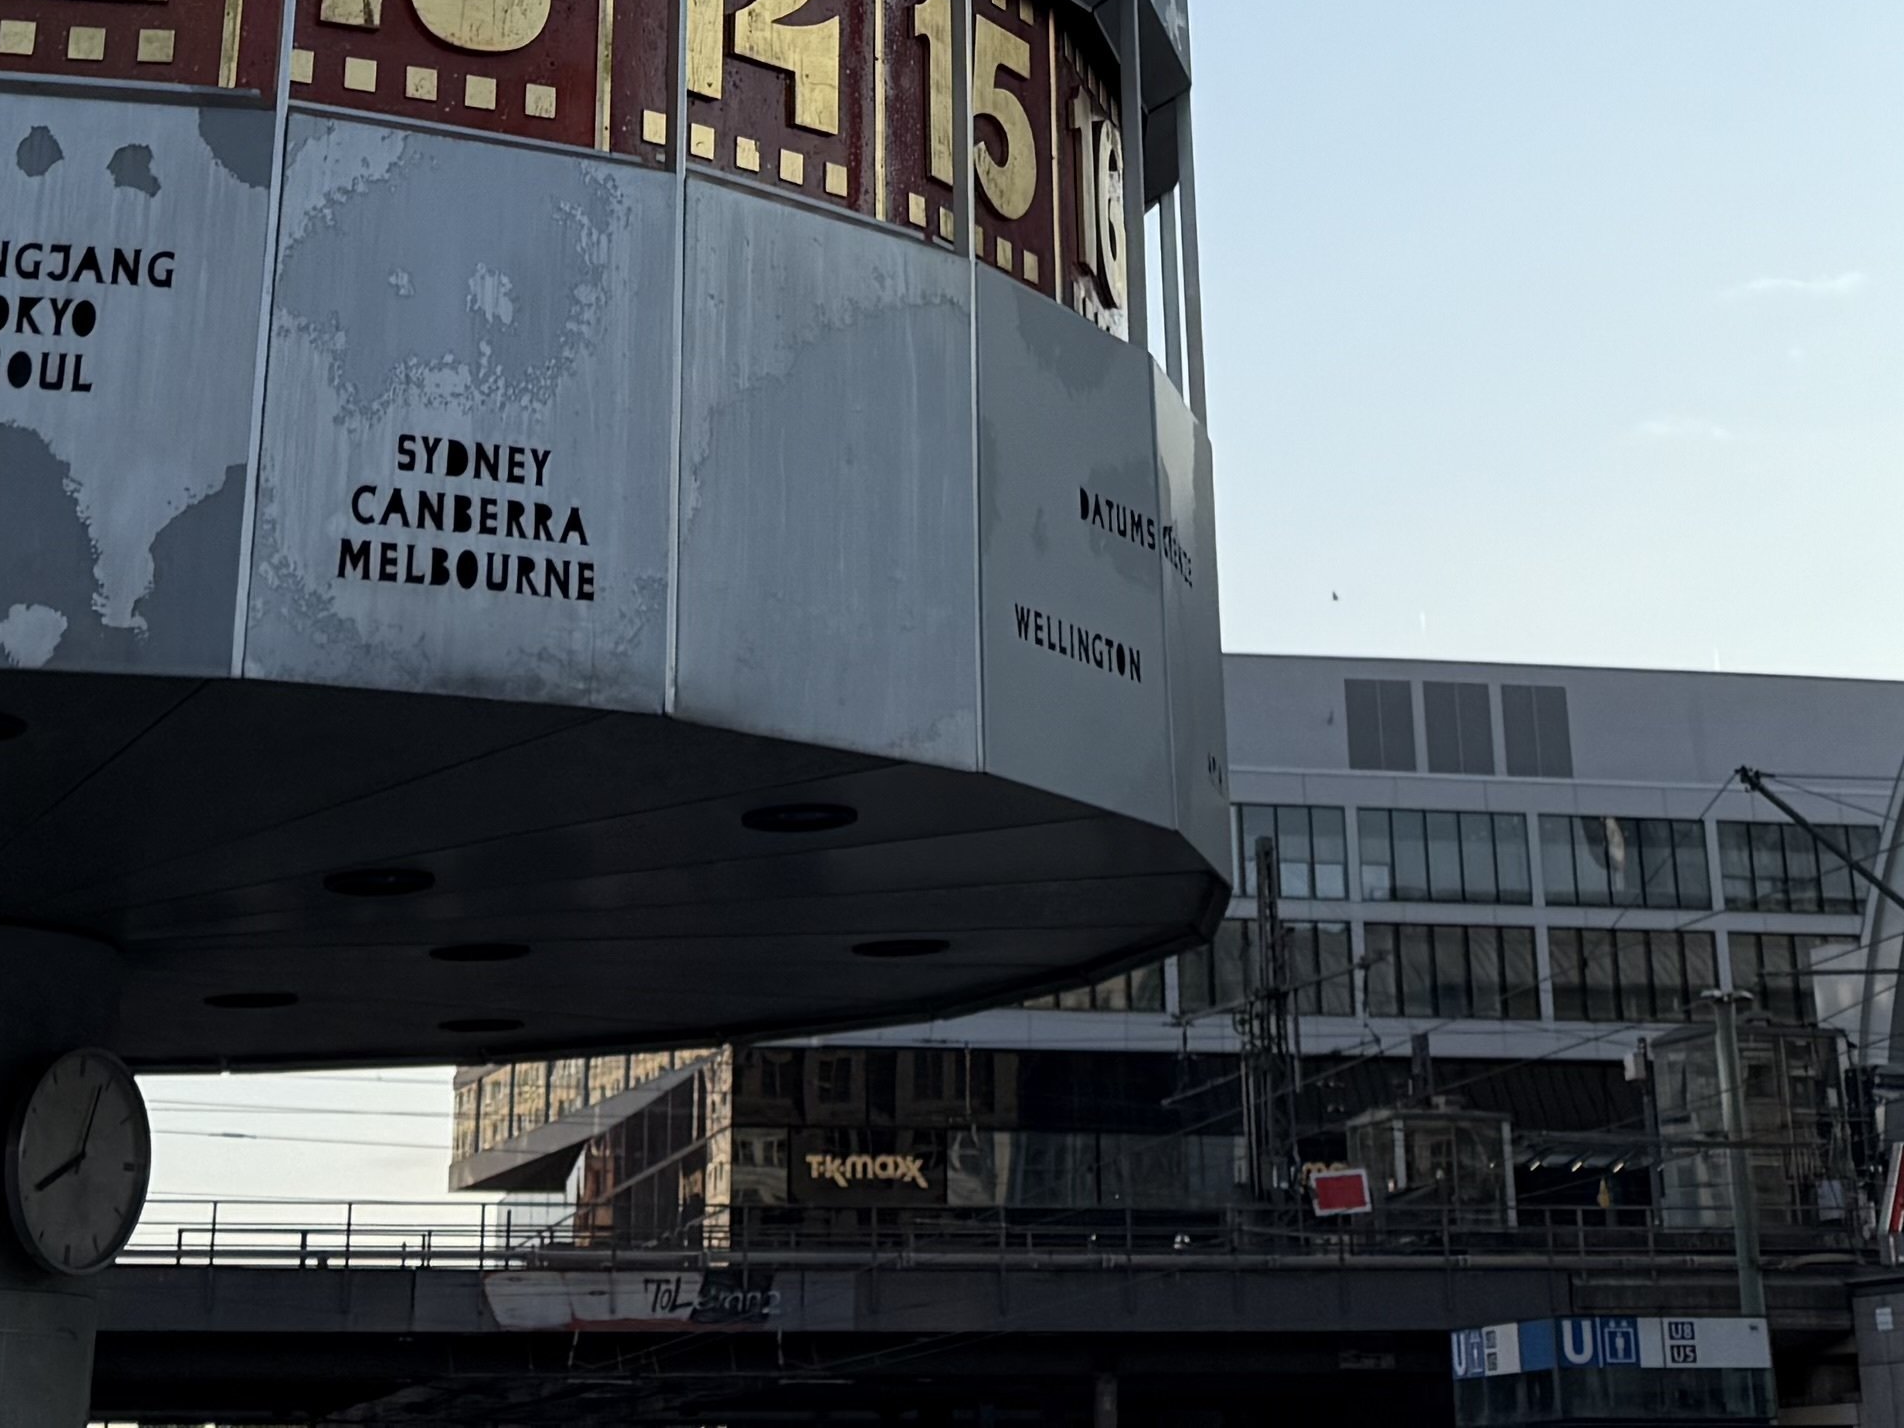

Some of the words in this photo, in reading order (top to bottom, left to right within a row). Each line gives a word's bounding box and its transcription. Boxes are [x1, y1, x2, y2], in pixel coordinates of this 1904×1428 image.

[397, 434, 552, 487] SYDNEY
[351, 485, 589, 545] CANBERRA
[337, 539, 596, 601] MELBOURNE
[1015, 603, 1141, 683] WELLINGTON
[1561, 1319, 1593, 1364] U
[1670, 1323, 1694, 1339] U8
[1672, 1346, 1696, 1362] U5
